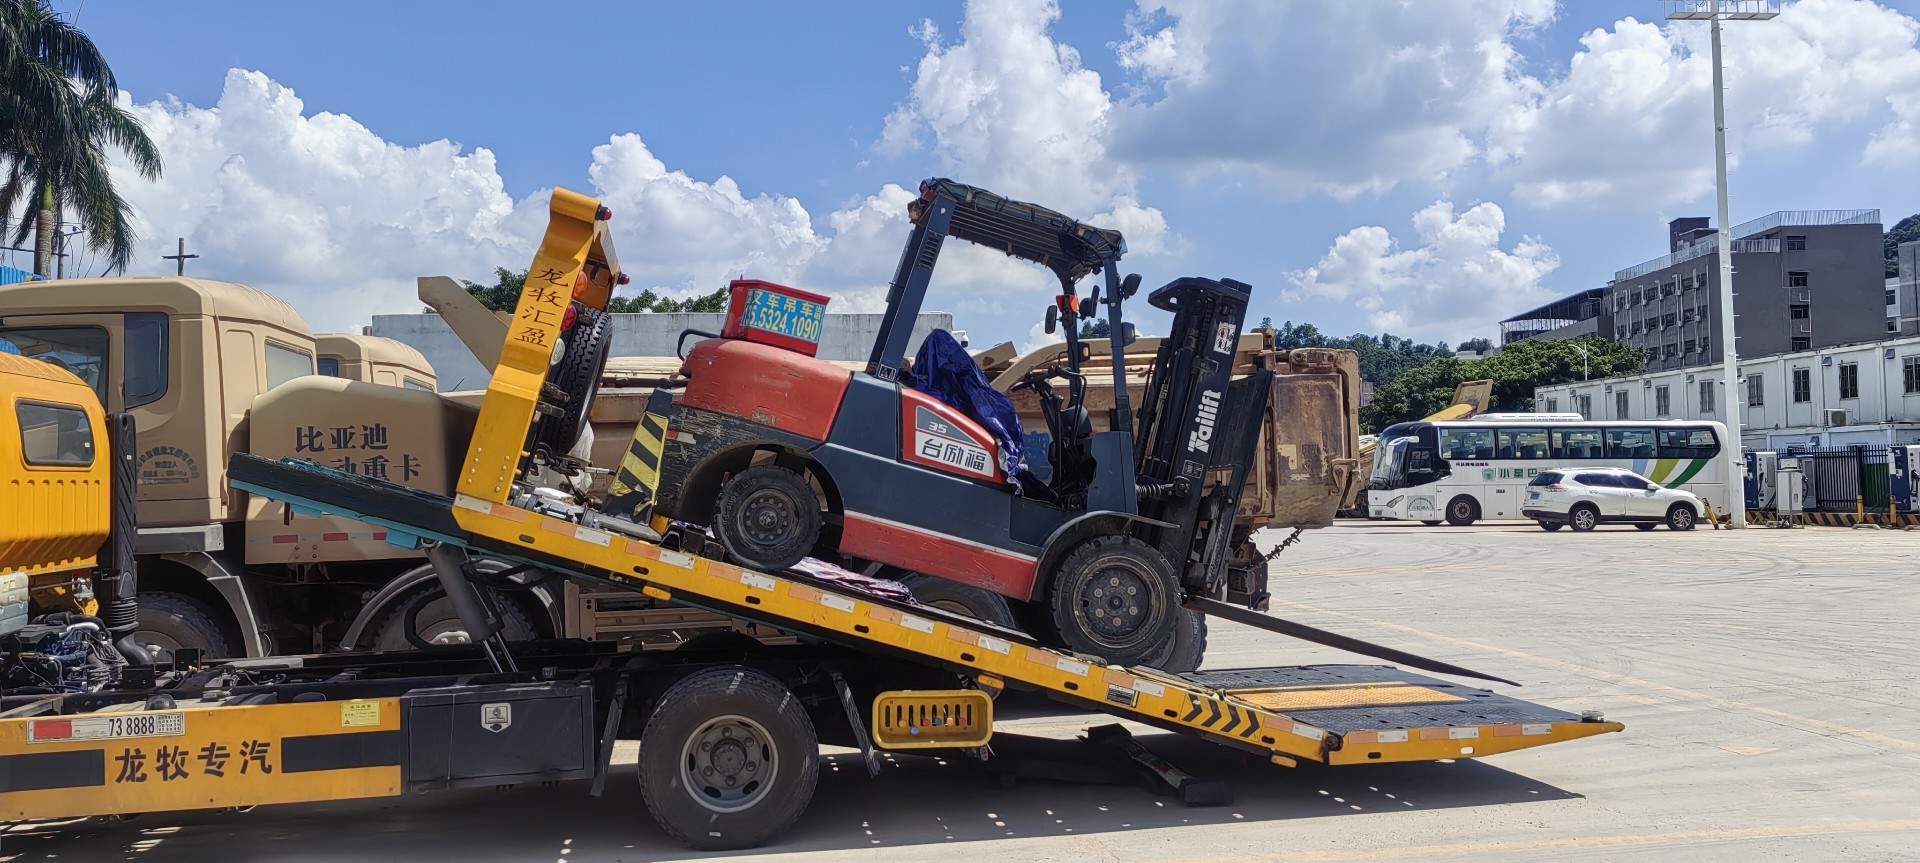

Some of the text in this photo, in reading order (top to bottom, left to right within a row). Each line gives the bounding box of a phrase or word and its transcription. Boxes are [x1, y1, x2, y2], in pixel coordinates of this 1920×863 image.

[514, 267, 569, 349] 龙牧汇盈
[928, 421, 948, 434] 35
[1187, 389, 1222, 454] Tailift
[295, 423, 389, 453] 比亚迪
[300, 454, 422, 482] 动重卡
[921, 438, 987, 471] 台励福
[108, 718, 123, 737] 73
[126, 715, 156, 736] 8888
[114, 740, 273, 784] 龙牧专汽
